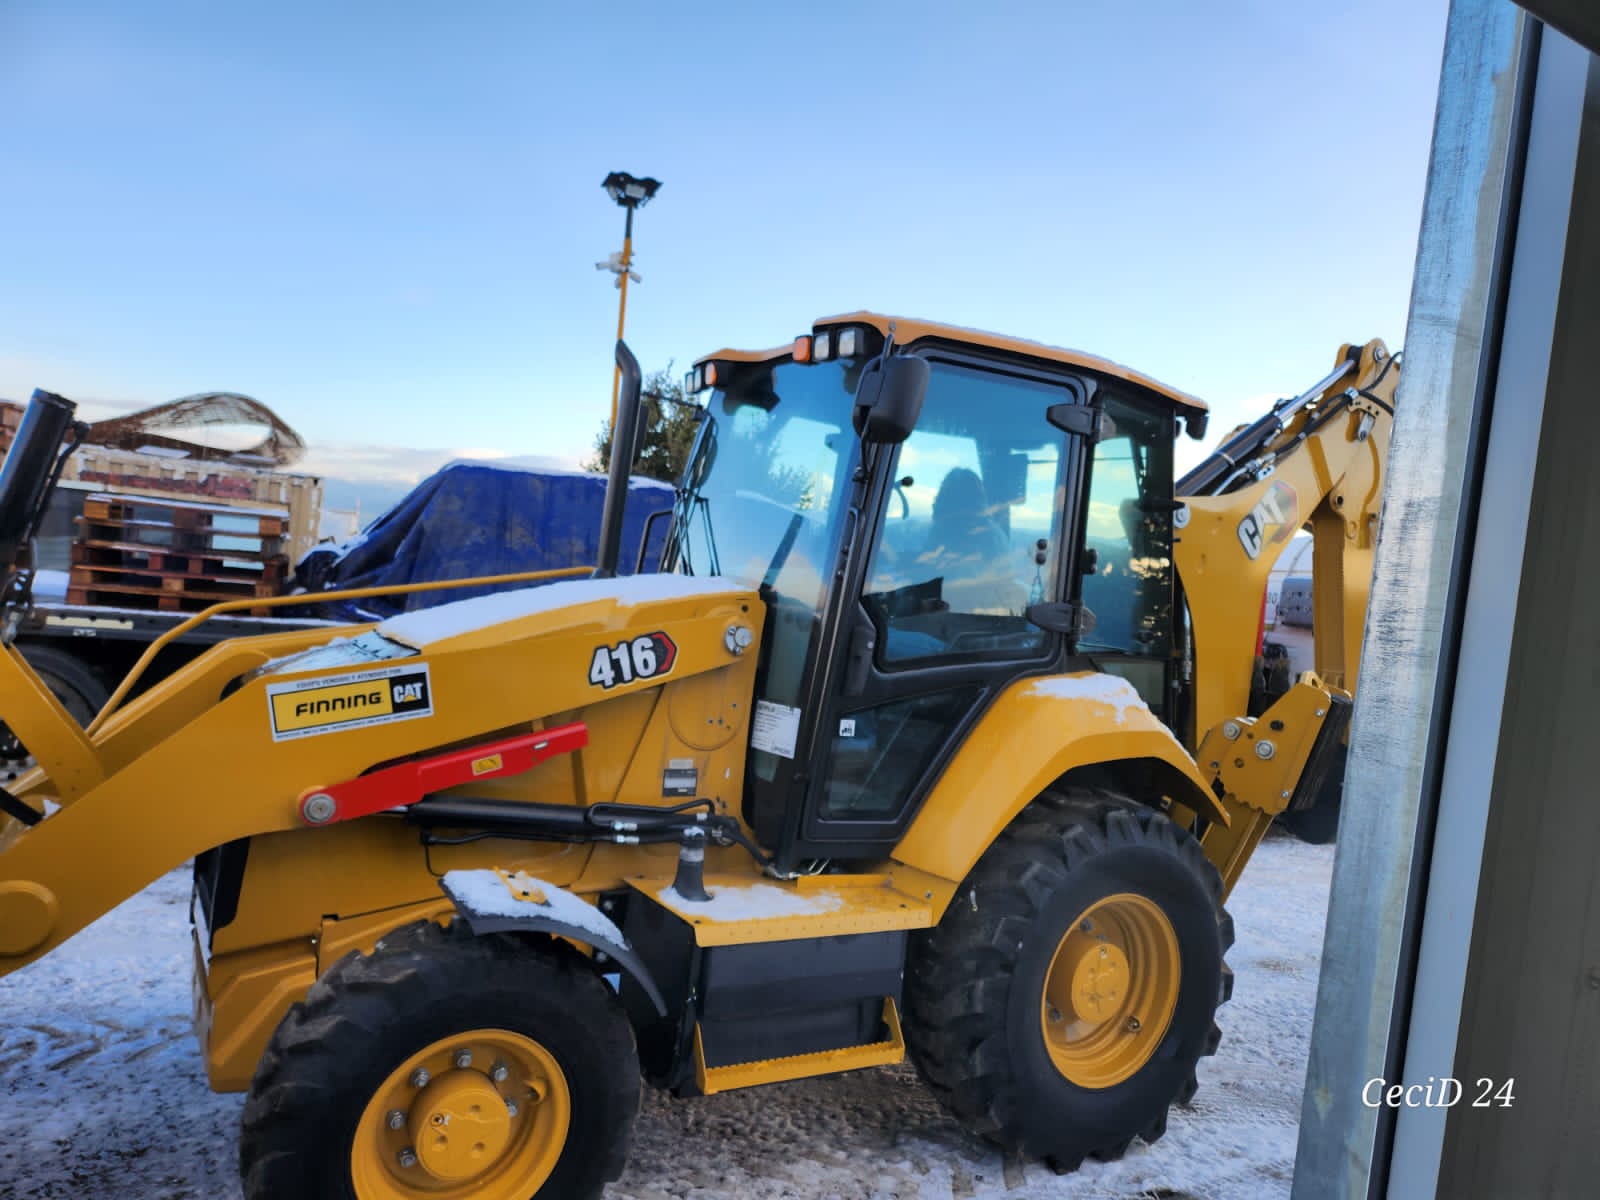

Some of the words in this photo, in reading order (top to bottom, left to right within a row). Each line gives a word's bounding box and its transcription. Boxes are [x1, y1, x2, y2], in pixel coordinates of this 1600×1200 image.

[1238, 486, 1287, 559] CAT
[589, 636, 657, 687] 416
[295, 691, 381, 717] FINNING
[393, 682, 424, 703] CAT
